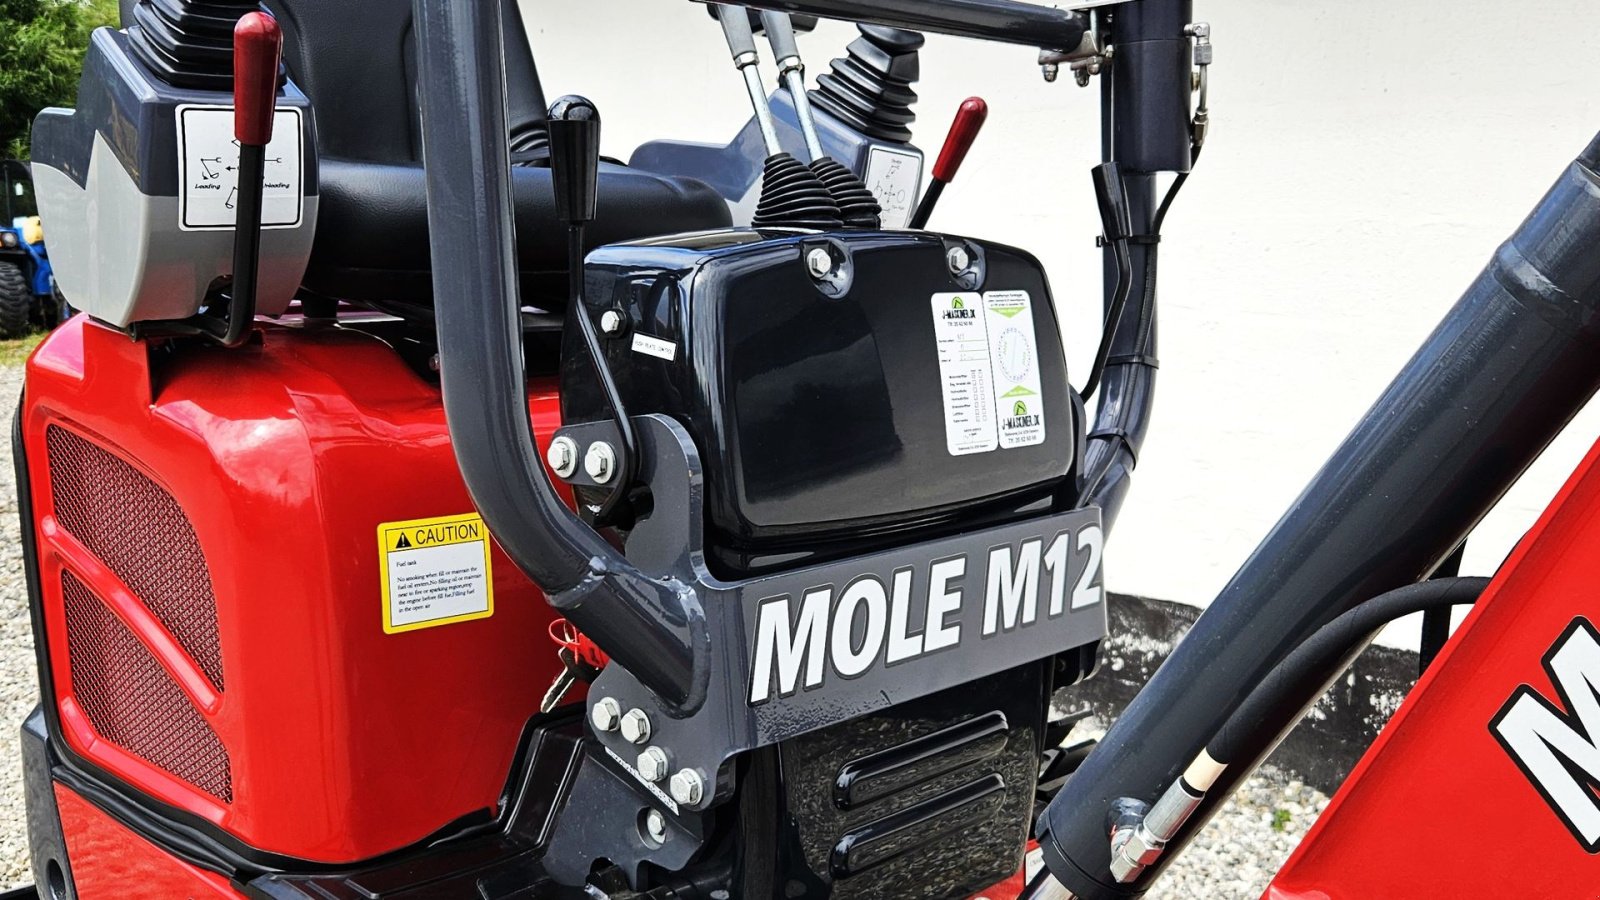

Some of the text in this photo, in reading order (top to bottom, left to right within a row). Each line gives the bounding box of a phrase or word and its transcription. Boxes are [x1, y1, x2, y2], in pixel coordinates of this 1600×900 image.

[415, 522, 478, 545] CAUTION
[405, 574, 425, 582] smoking
[438, 577, 451, 585] filling
[429, 586, 448, 594] sparking
[748, 523, 1101, 704] MOLE M12
